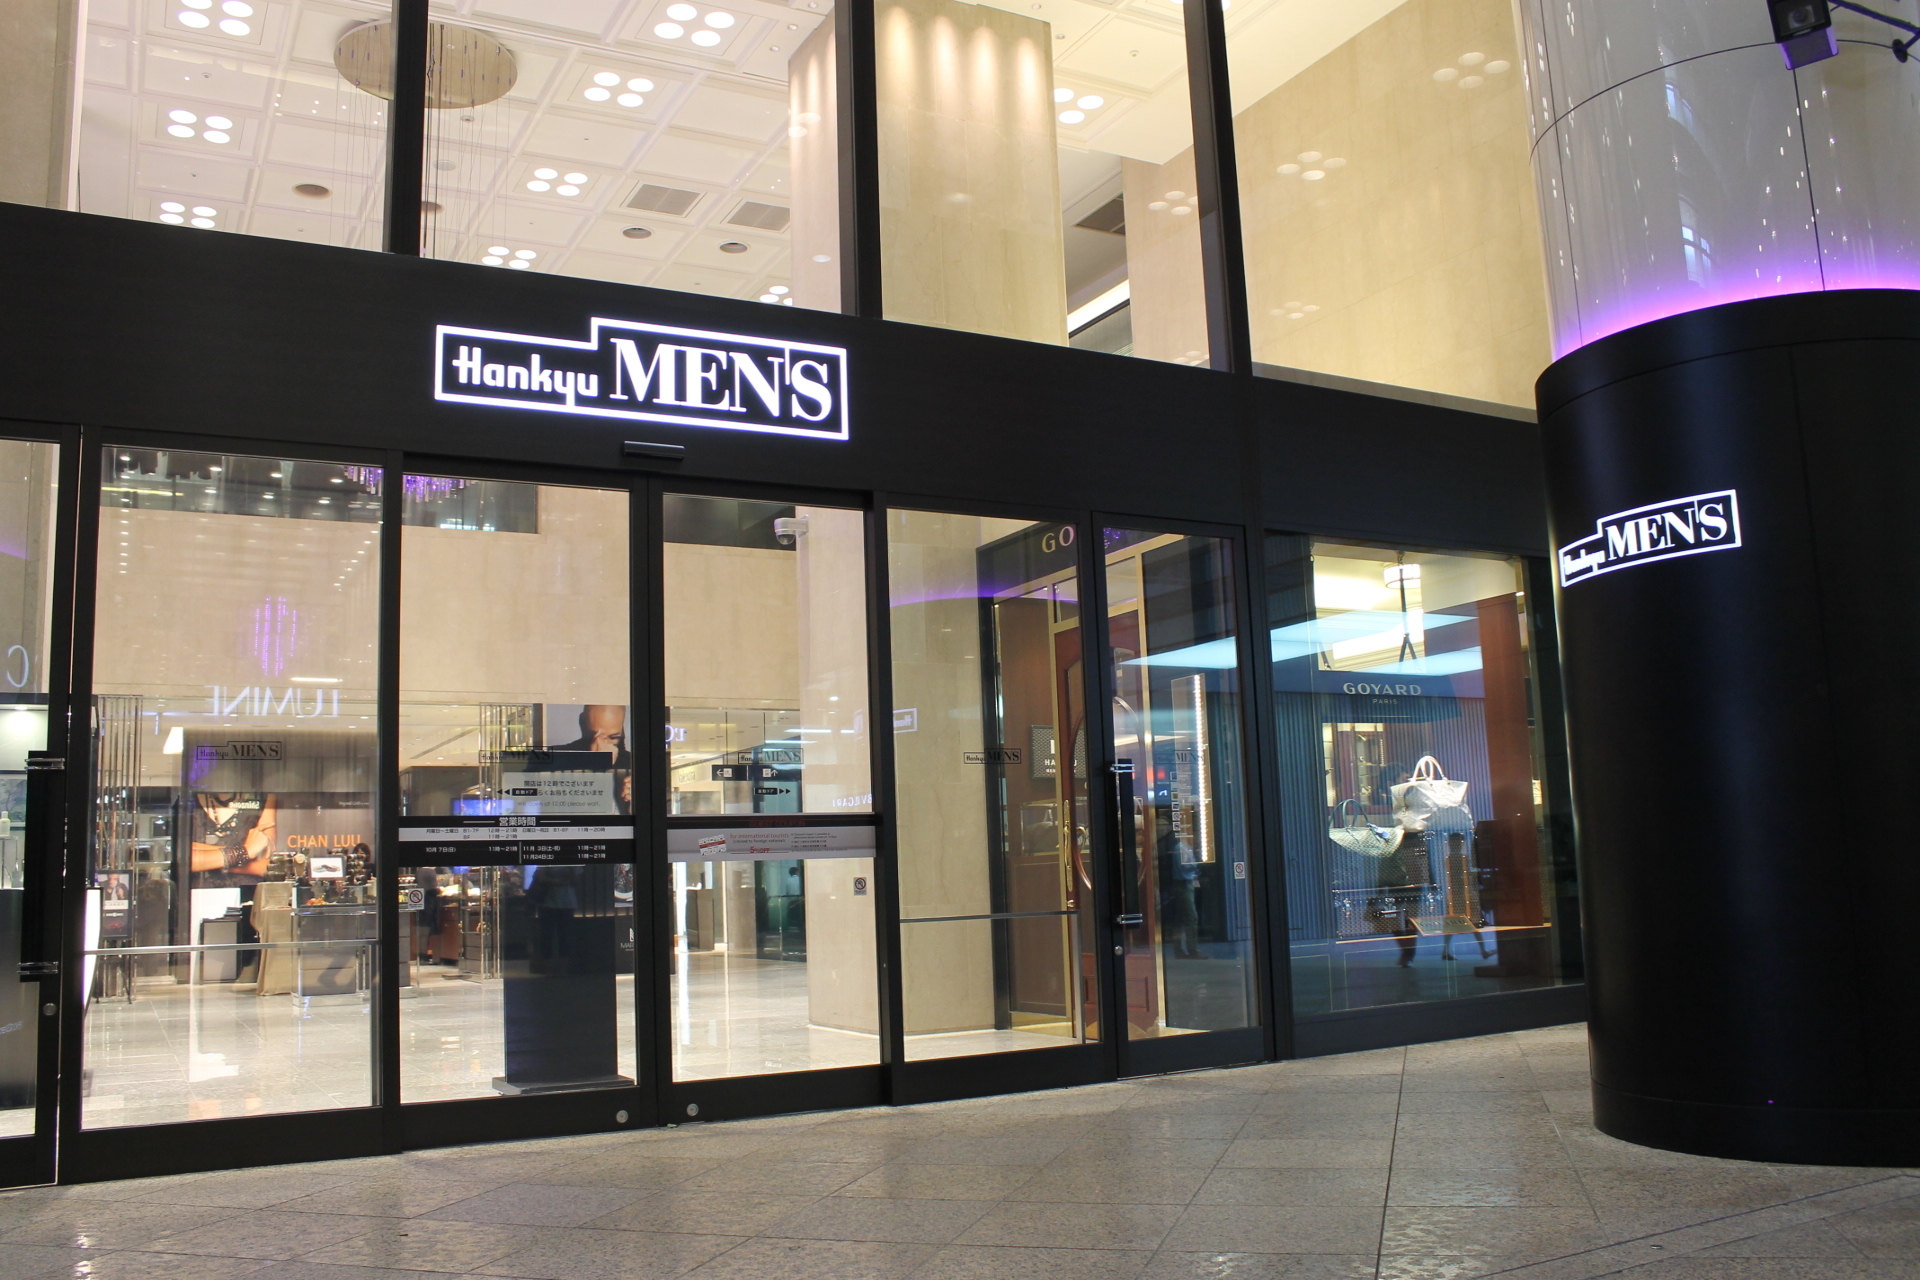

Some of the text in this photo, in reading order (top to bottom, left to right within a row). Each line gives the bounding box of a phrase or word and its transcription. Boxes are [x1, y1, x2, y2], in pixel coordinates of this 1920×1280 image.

[452, 345, 599, 406] Hankyu
[1343, 682, 1422, 696] GOYARD
[499, 816, 536, 827] 営業時間
[286, 834, 361, 848] CHAN LUU
